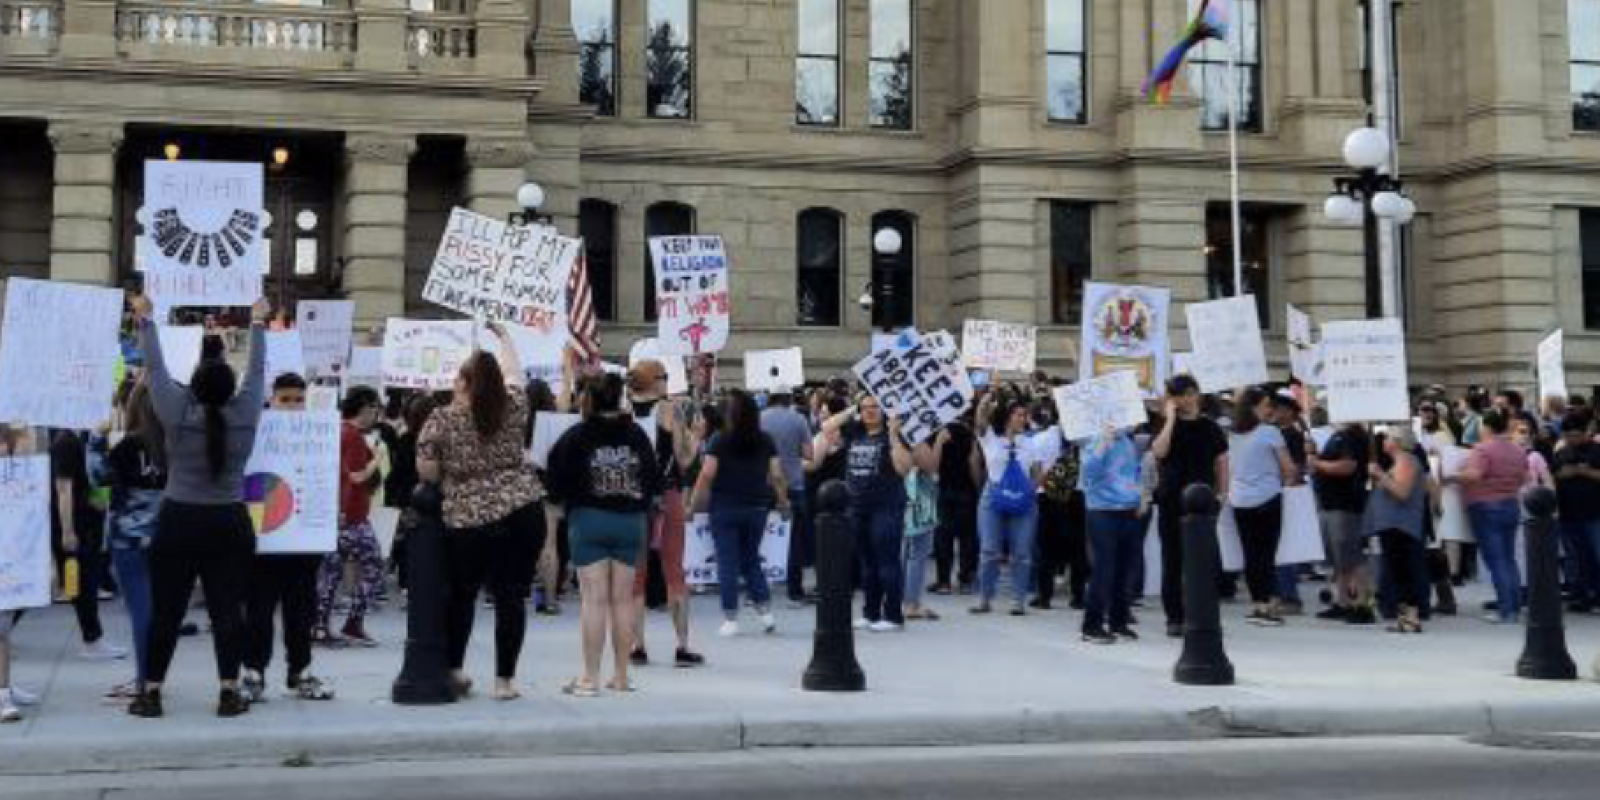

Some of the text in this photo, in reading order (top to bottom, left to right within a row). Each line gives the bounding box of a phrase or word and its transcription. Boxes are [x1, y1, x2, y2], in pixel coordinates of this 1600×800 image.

[436, 255, 559, 304] SOME HUMAN
[510, 255, 550, 282] FOR
[662, 273, 718, 292] OUT OF
[862, 366, 922, 442] LEGAL
[874, 349, 940, 430] ABORTION
[901, 343, 964, 408] KEEP
